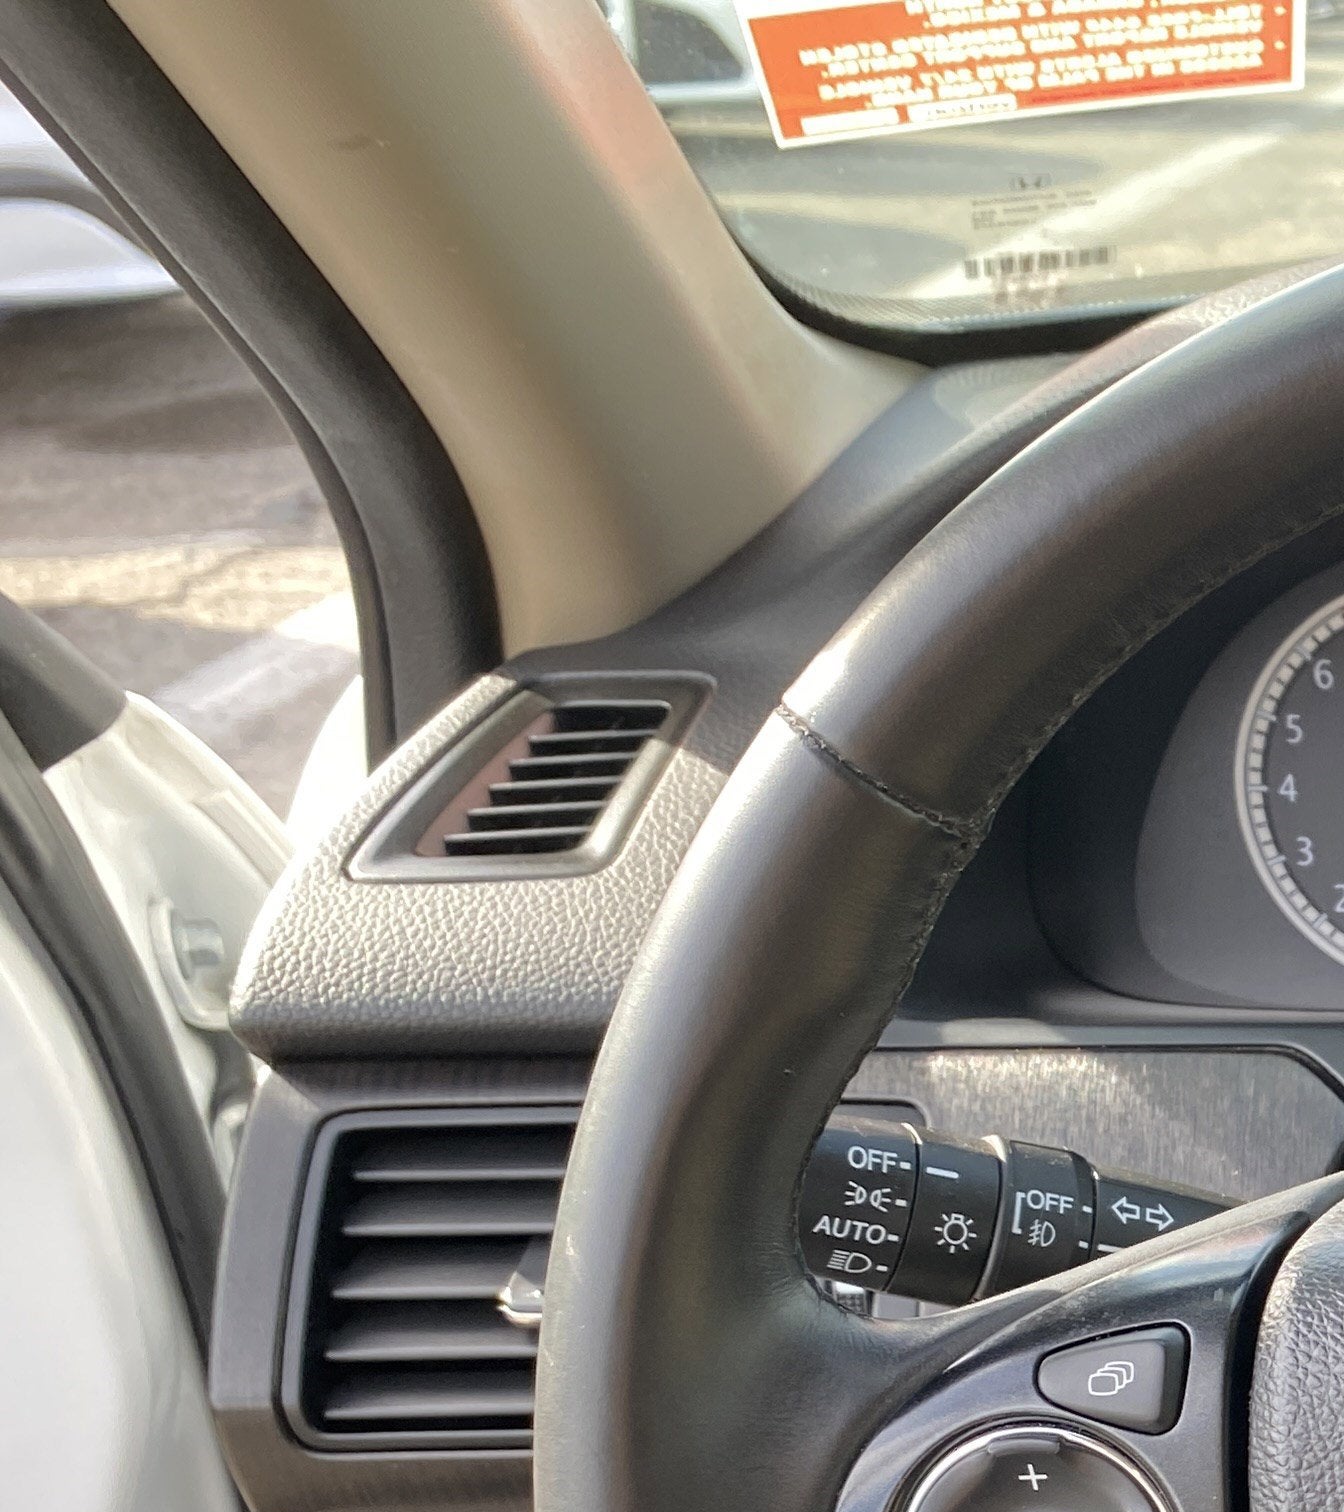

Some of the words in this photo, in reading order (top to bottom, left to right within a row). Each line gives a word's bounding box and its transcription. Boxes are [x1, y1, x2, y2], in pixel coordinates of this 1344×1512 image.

[1314, 659, 1334, 690] 6
[1286, 716, 1303, 744] 5
[1279, 774, 1298, 801] 4
[1297, 837, 1314, 866] 3
[848, 1146, 898, 1172] OFF
[1026, 1189, 1074, 1215] OFF
[812, 1215, 888, 1246] AUTO
